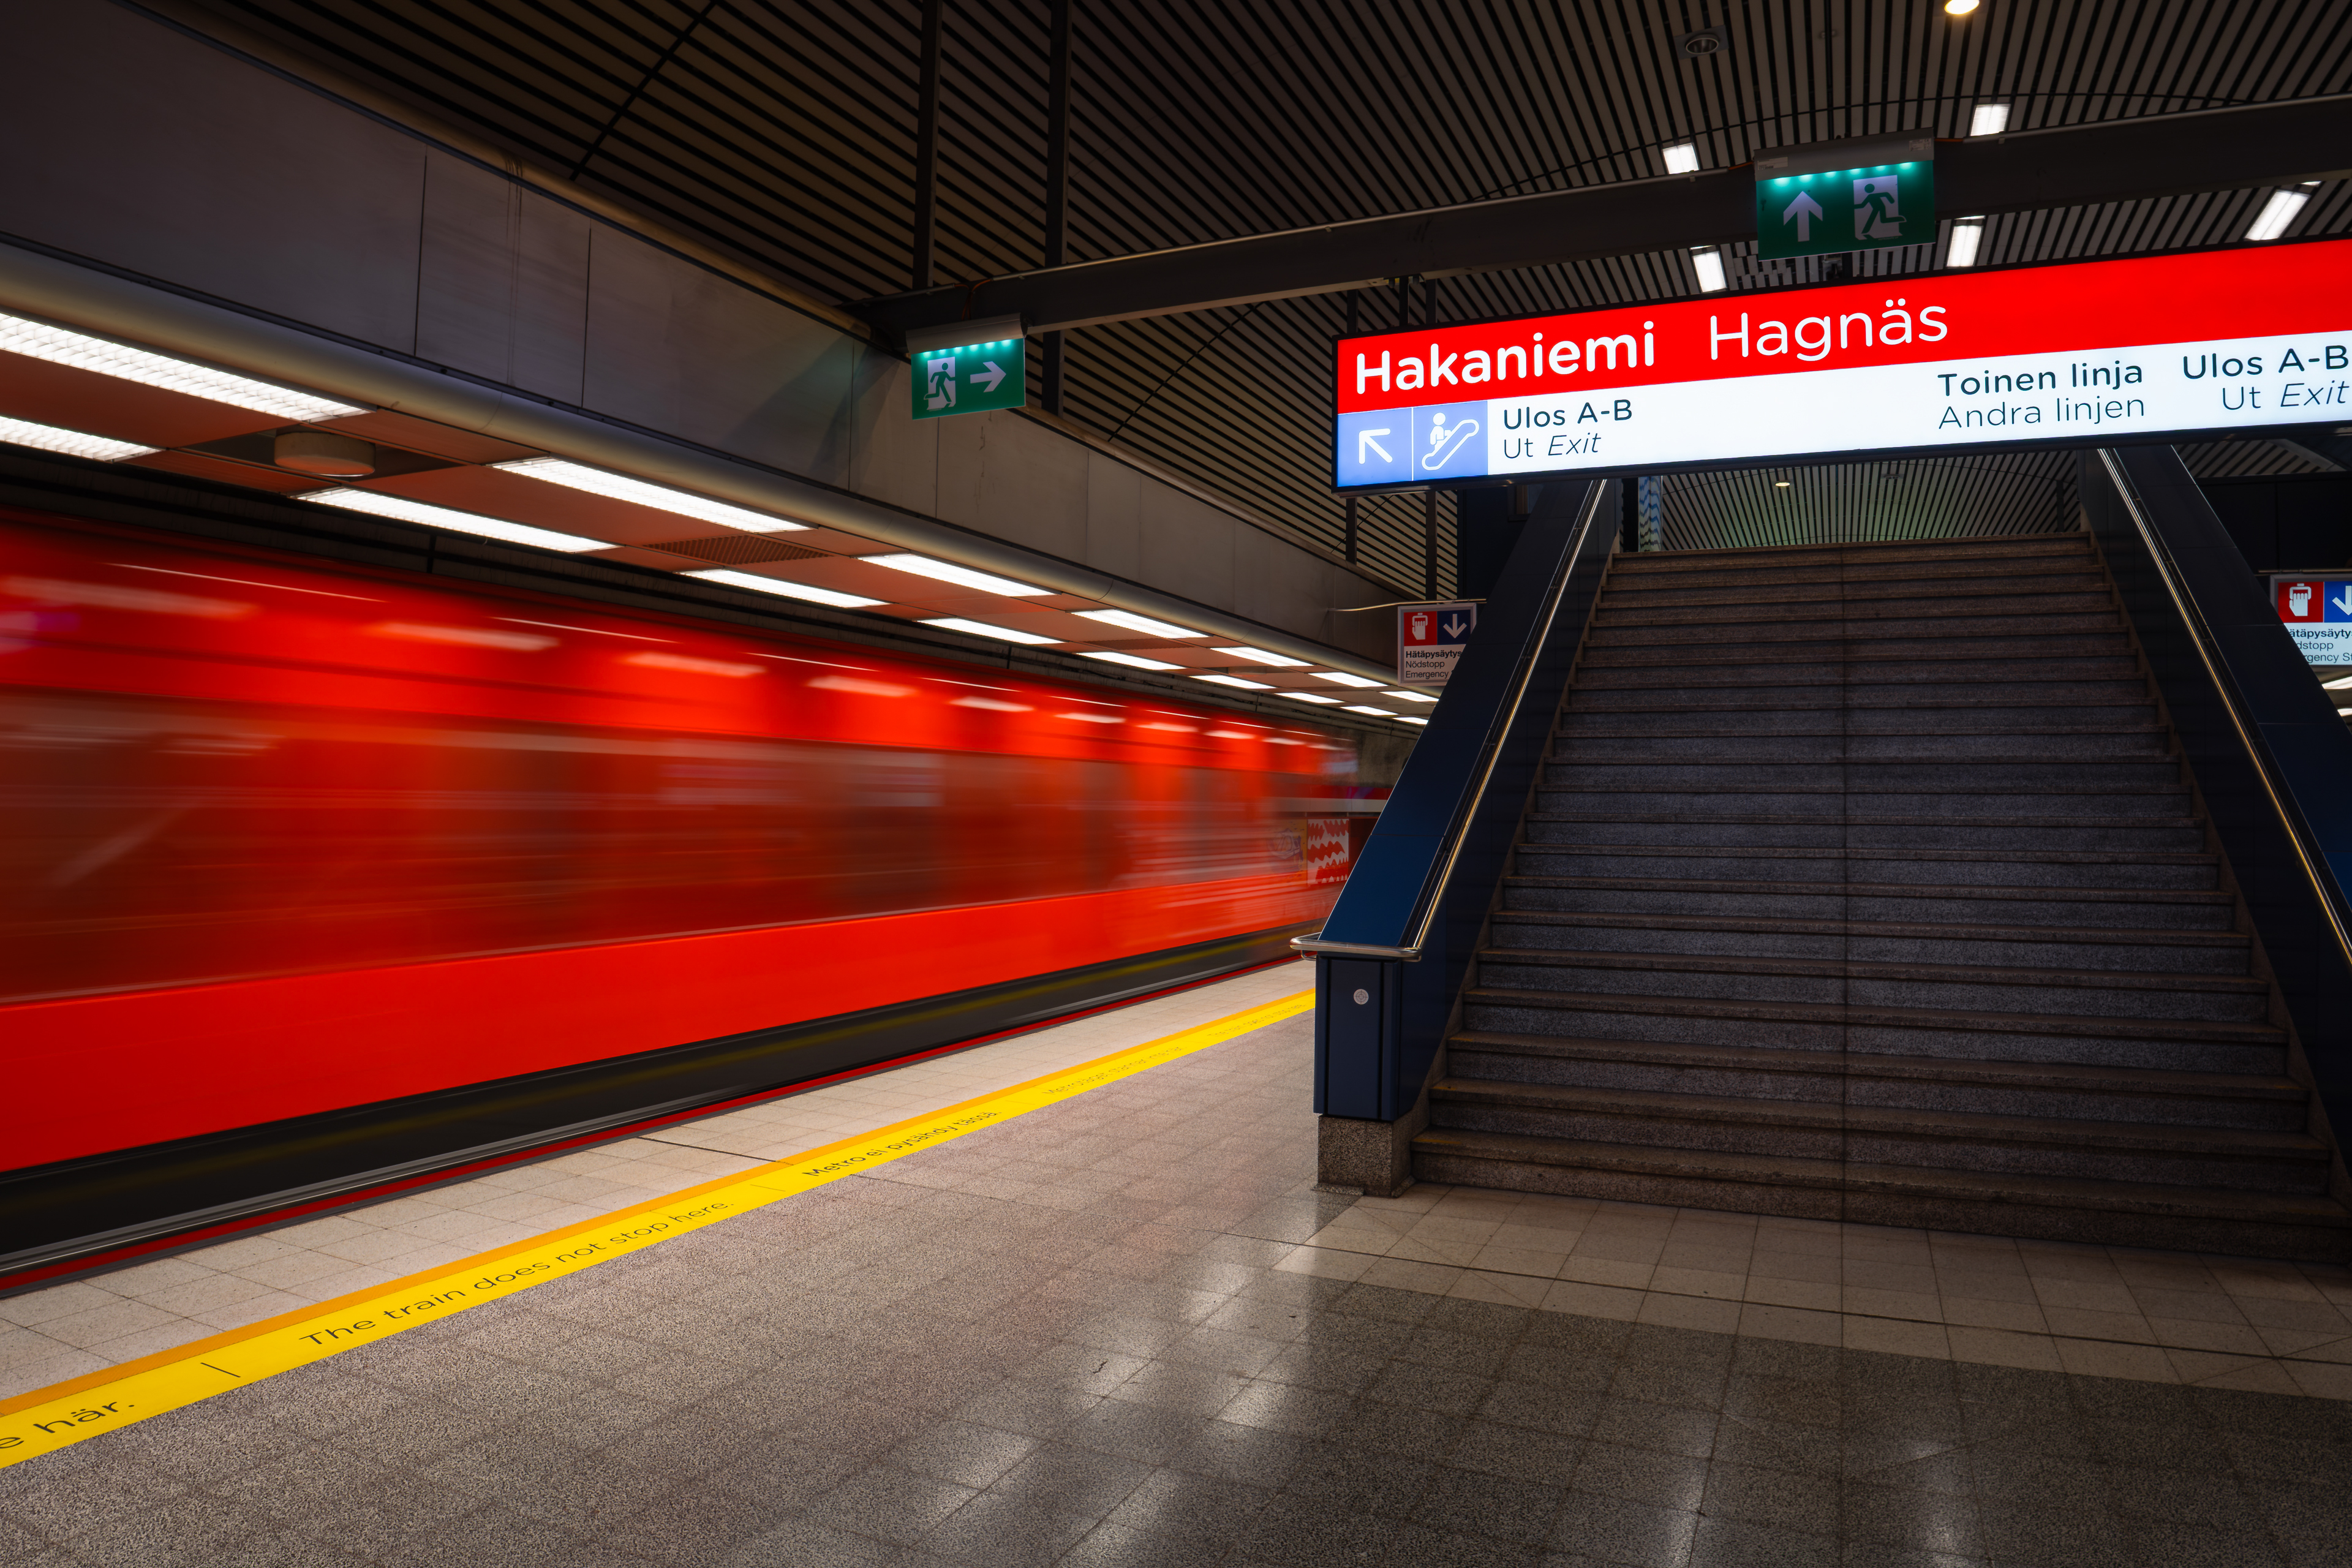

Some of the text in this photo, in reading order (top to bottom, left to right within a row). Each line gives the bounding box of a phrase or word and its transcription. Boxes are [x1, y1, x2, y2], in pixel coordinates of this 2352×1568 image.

[1356, 297, 1948, 394] Hakaniemi Hagnäs
[2183, 345, 2349, 379] Ulos A-B
[1937, 360, 2142, 396] Toinen linja
[2222, 380, 2350, 410] Ut Exit
[1504, 399, 1632, 429] Ulos A-B
[1939, 396, 2144, 429] Andra linjen
[1504, 432, 1601, 459] Ut Exit
[2290, 628, 2352, 639] ätäpysäyty
[2296, 641, 2334, 651] dstopp
[1406, 650, 1462, 659] Hätäpysäytys
[1406, 660, 1445, 669] Nödstopp
[1406, 671, 1449, 679] Emergency
[802, 1156, 866, 1177] Metro
[886, 1126, 959, 1150] pysähdy
[953, 1112, 1002, 1126] tässä.
[299, 1201, 734, 1344] The train does not stop here.
[33, 1401, 135, 1433] här.
